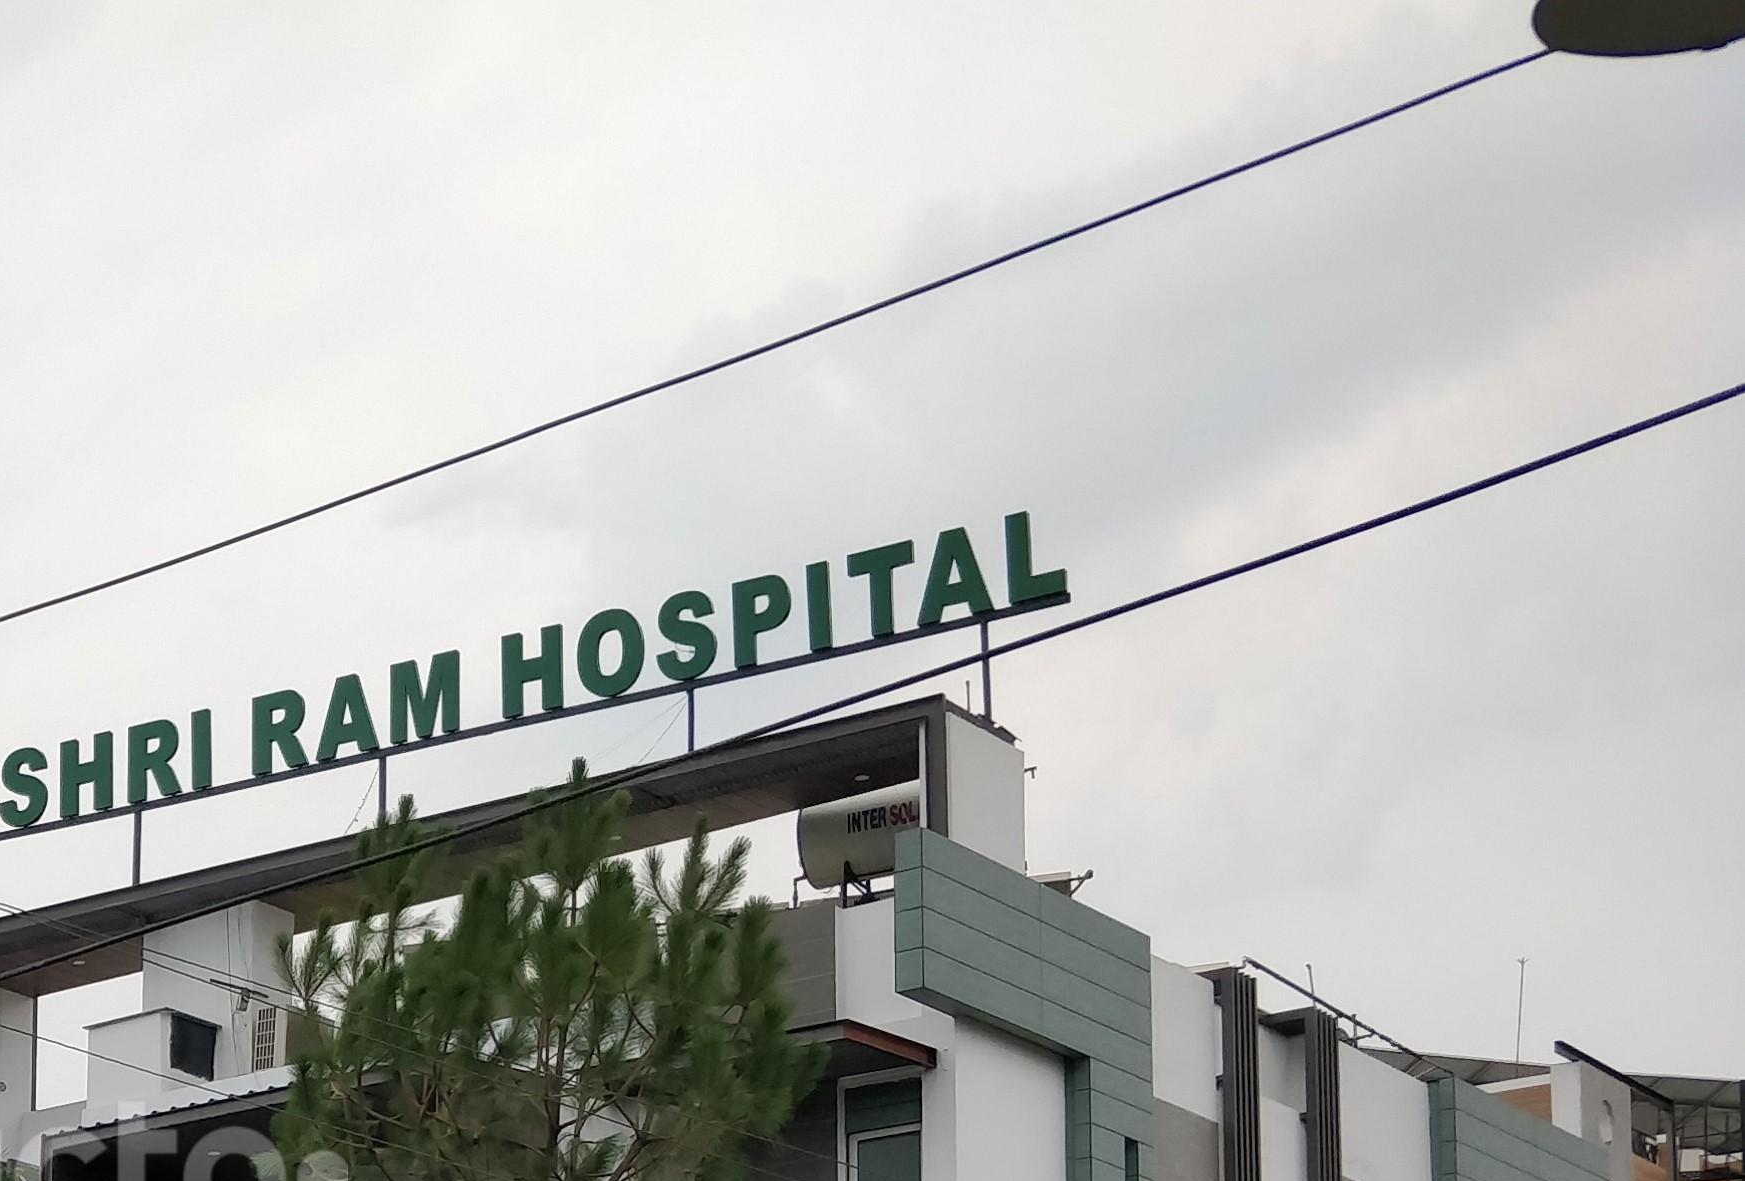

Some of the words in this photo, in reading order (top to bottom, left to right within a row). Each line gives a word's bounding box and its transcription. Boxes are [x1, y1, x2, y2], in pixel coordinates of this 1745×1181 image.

[0, 708, 212, 828] SHRI
[252, 650, 460, 778] RAM
[501, 510, 1068, 721] HOSPITAL
[846, 806, 887, 834] INTER
[889, 801, 920, 826] SOL
